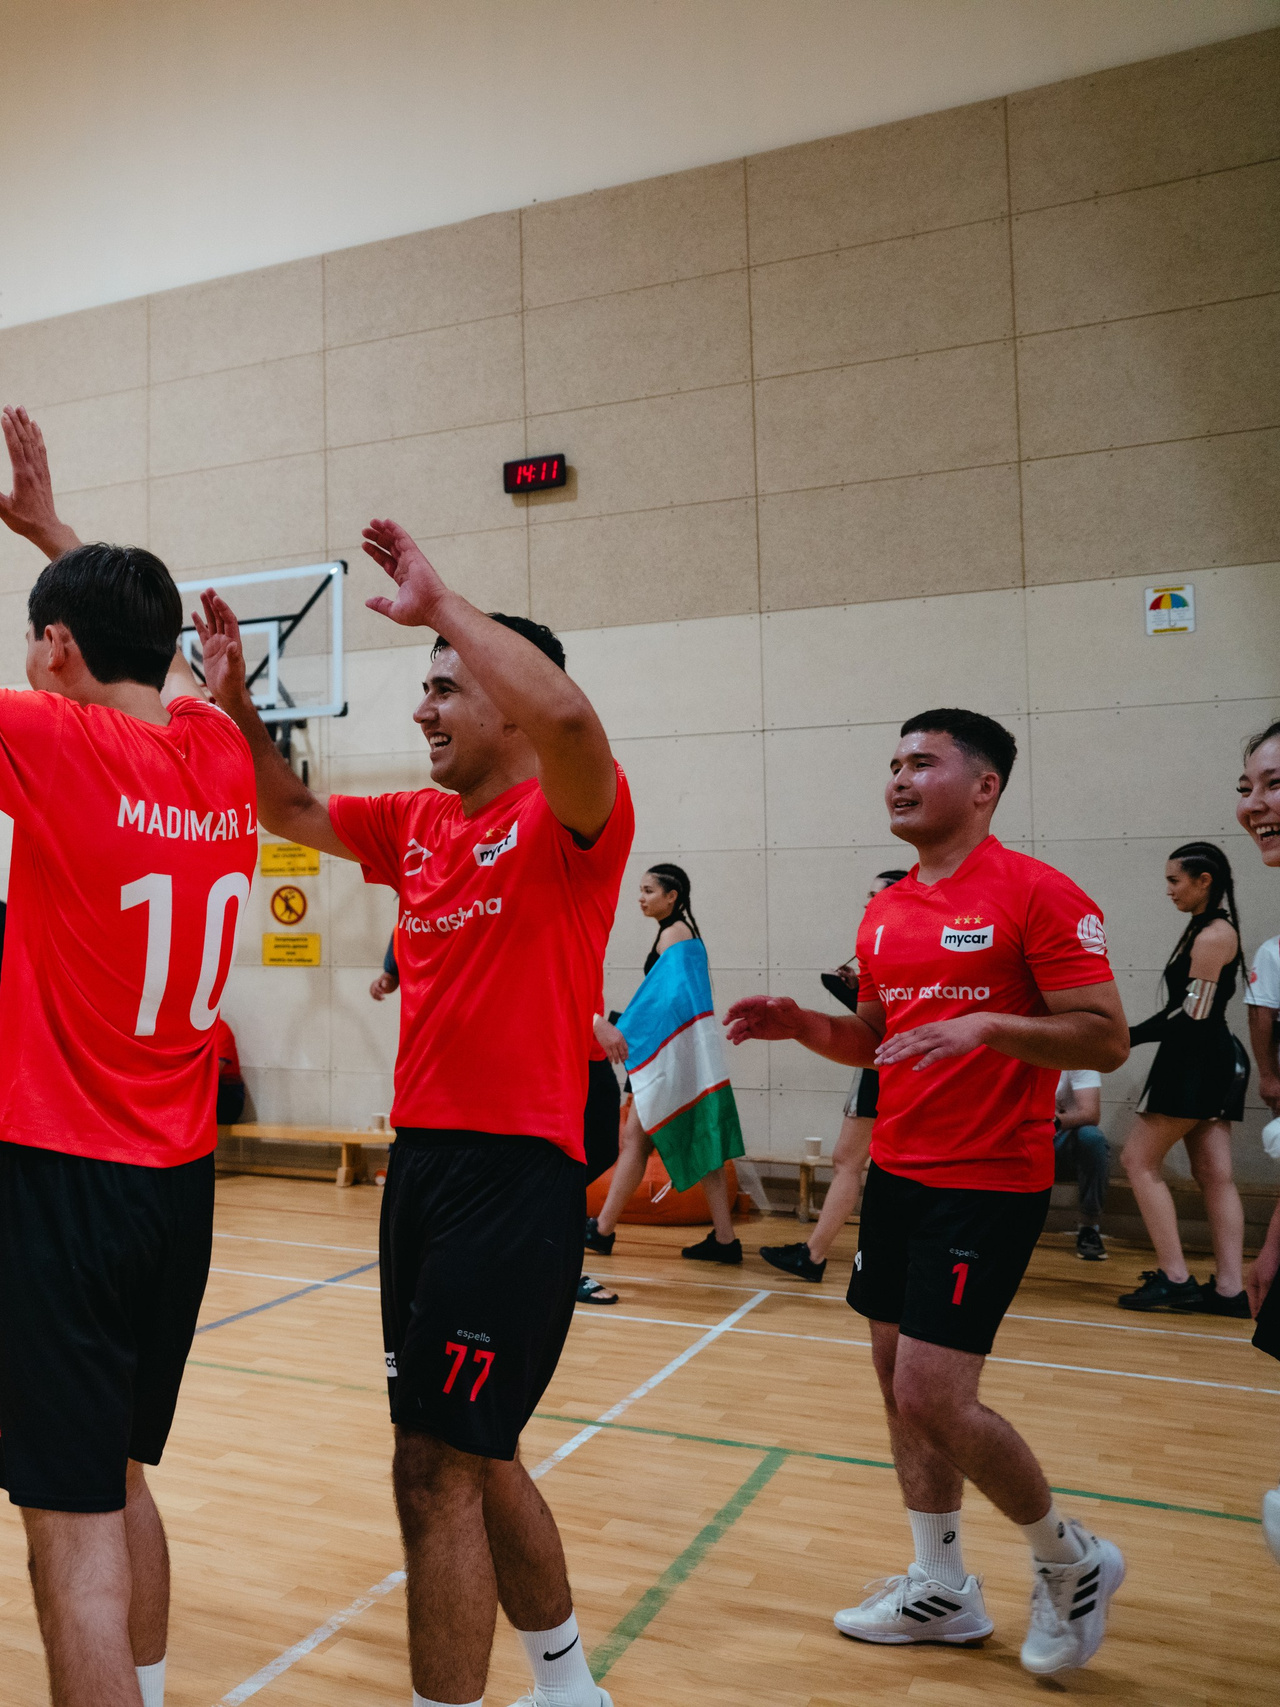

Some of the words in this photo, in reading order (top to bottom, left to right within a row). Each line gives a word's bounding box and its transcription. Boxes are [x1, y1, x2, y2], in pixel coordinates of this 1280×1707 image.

[516, 460, 558, 485] 14:11
[117, 794, 239, 842] MADIMAR
[121, 872, 250, 1037] 10
[874, 925, 885, 955] 1
[944, 934, 988, 947] mycar
[919, 982, 990, 1001] astana
[952, 1262, 969, 1306] 1
[457, 1329, 491, 1343] espello
[443, 1341, 496, 1402] 77
